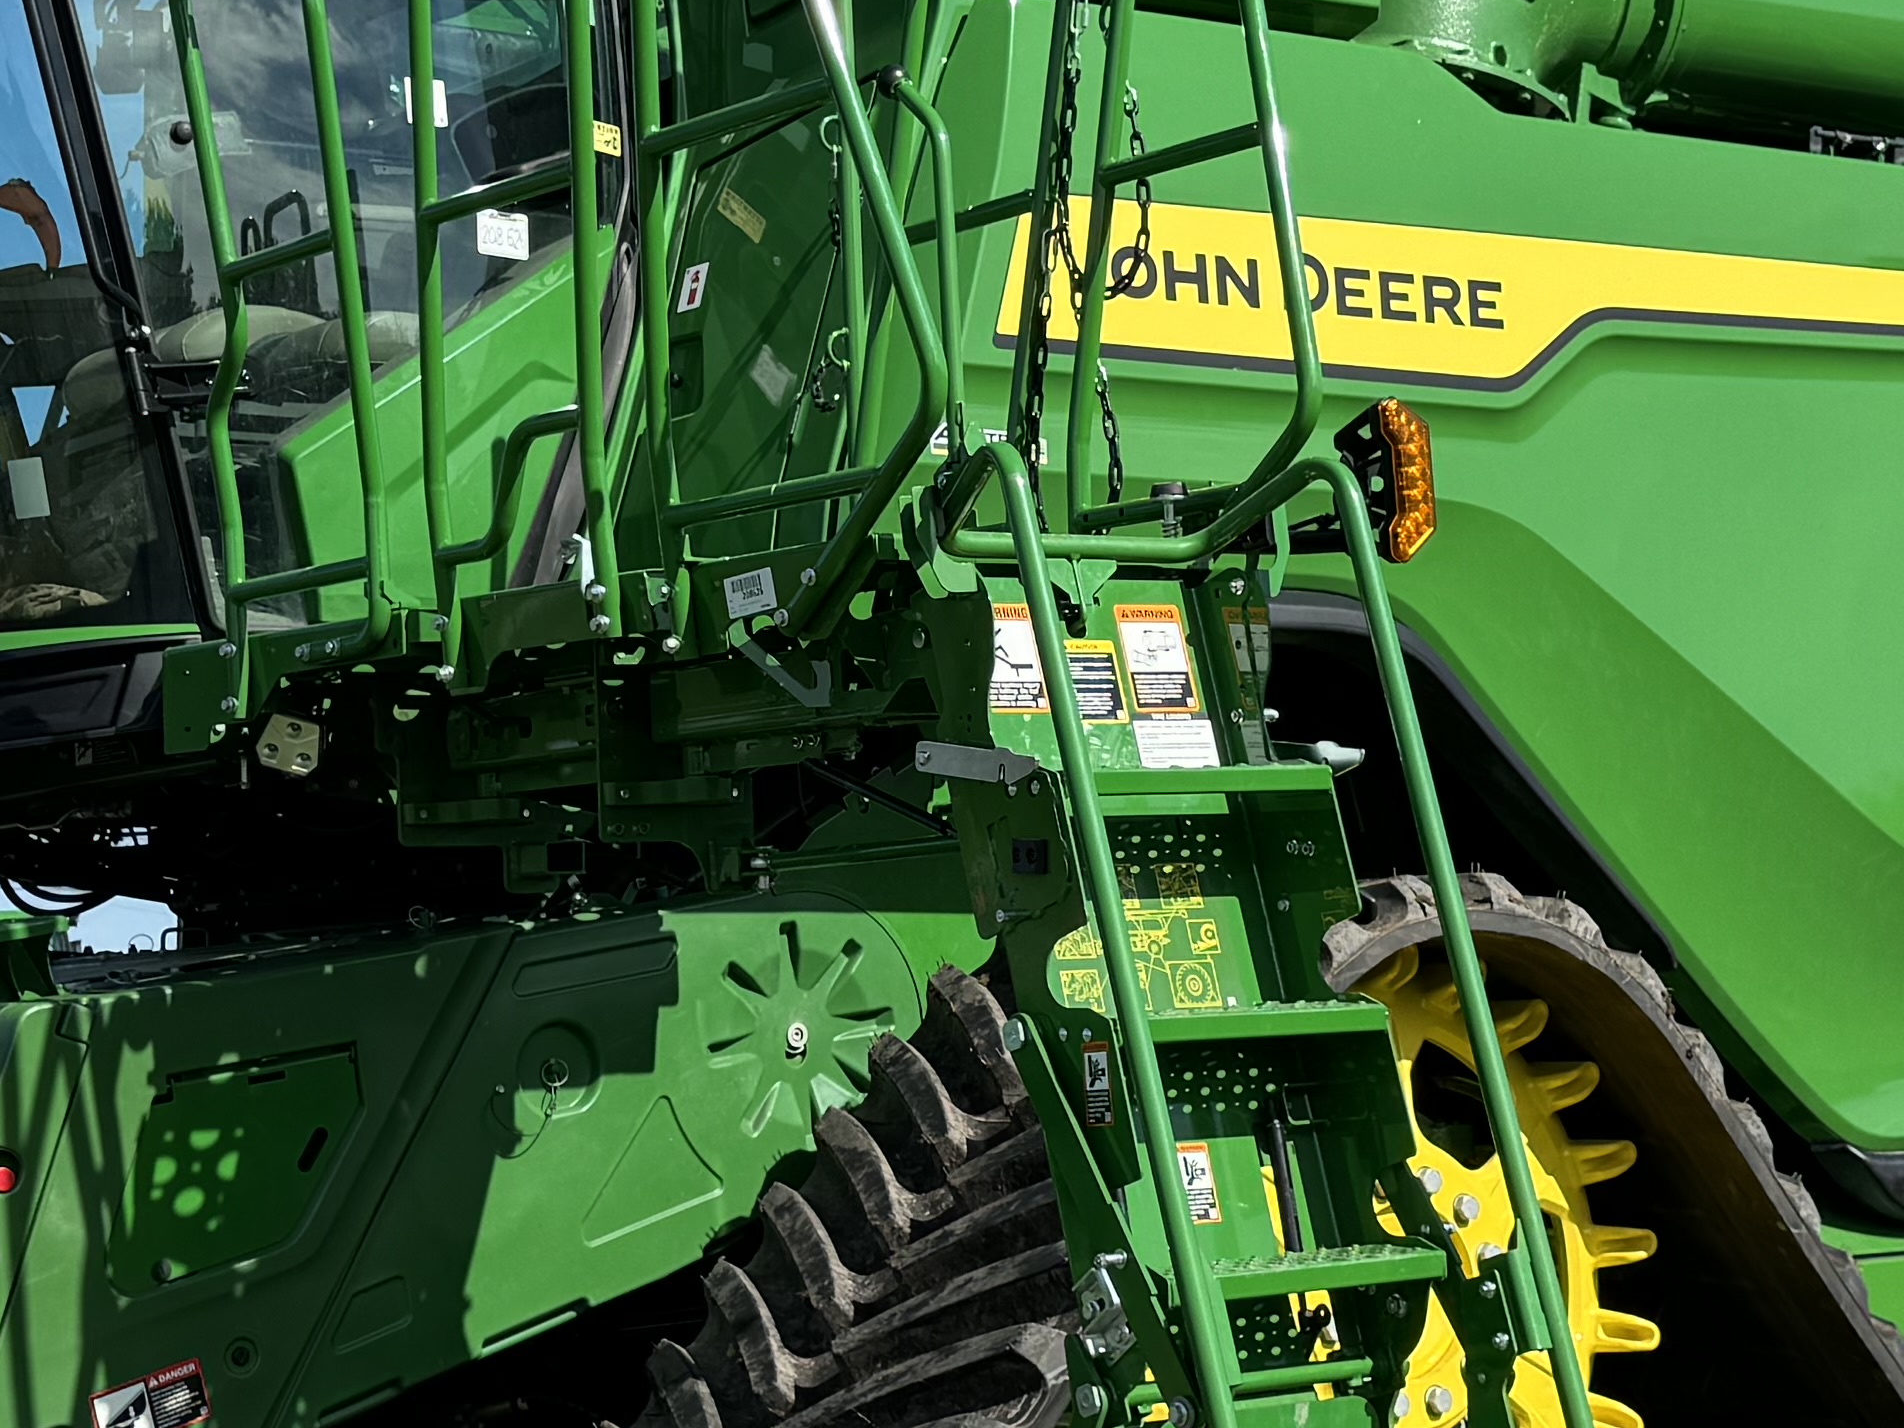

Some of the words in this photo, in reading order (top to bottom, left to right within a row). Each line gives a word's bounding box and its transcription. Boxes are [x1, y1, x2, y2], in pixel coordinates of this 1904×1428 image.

[1106, 245, 1261, 309] OHN
[1284, 252, 1505, 330] DEERE
[995, 607, 1028, 619] RNING
[1130, 609, 1174, 619] WARNING
[158, 1362, 196, 1383] DANGER
